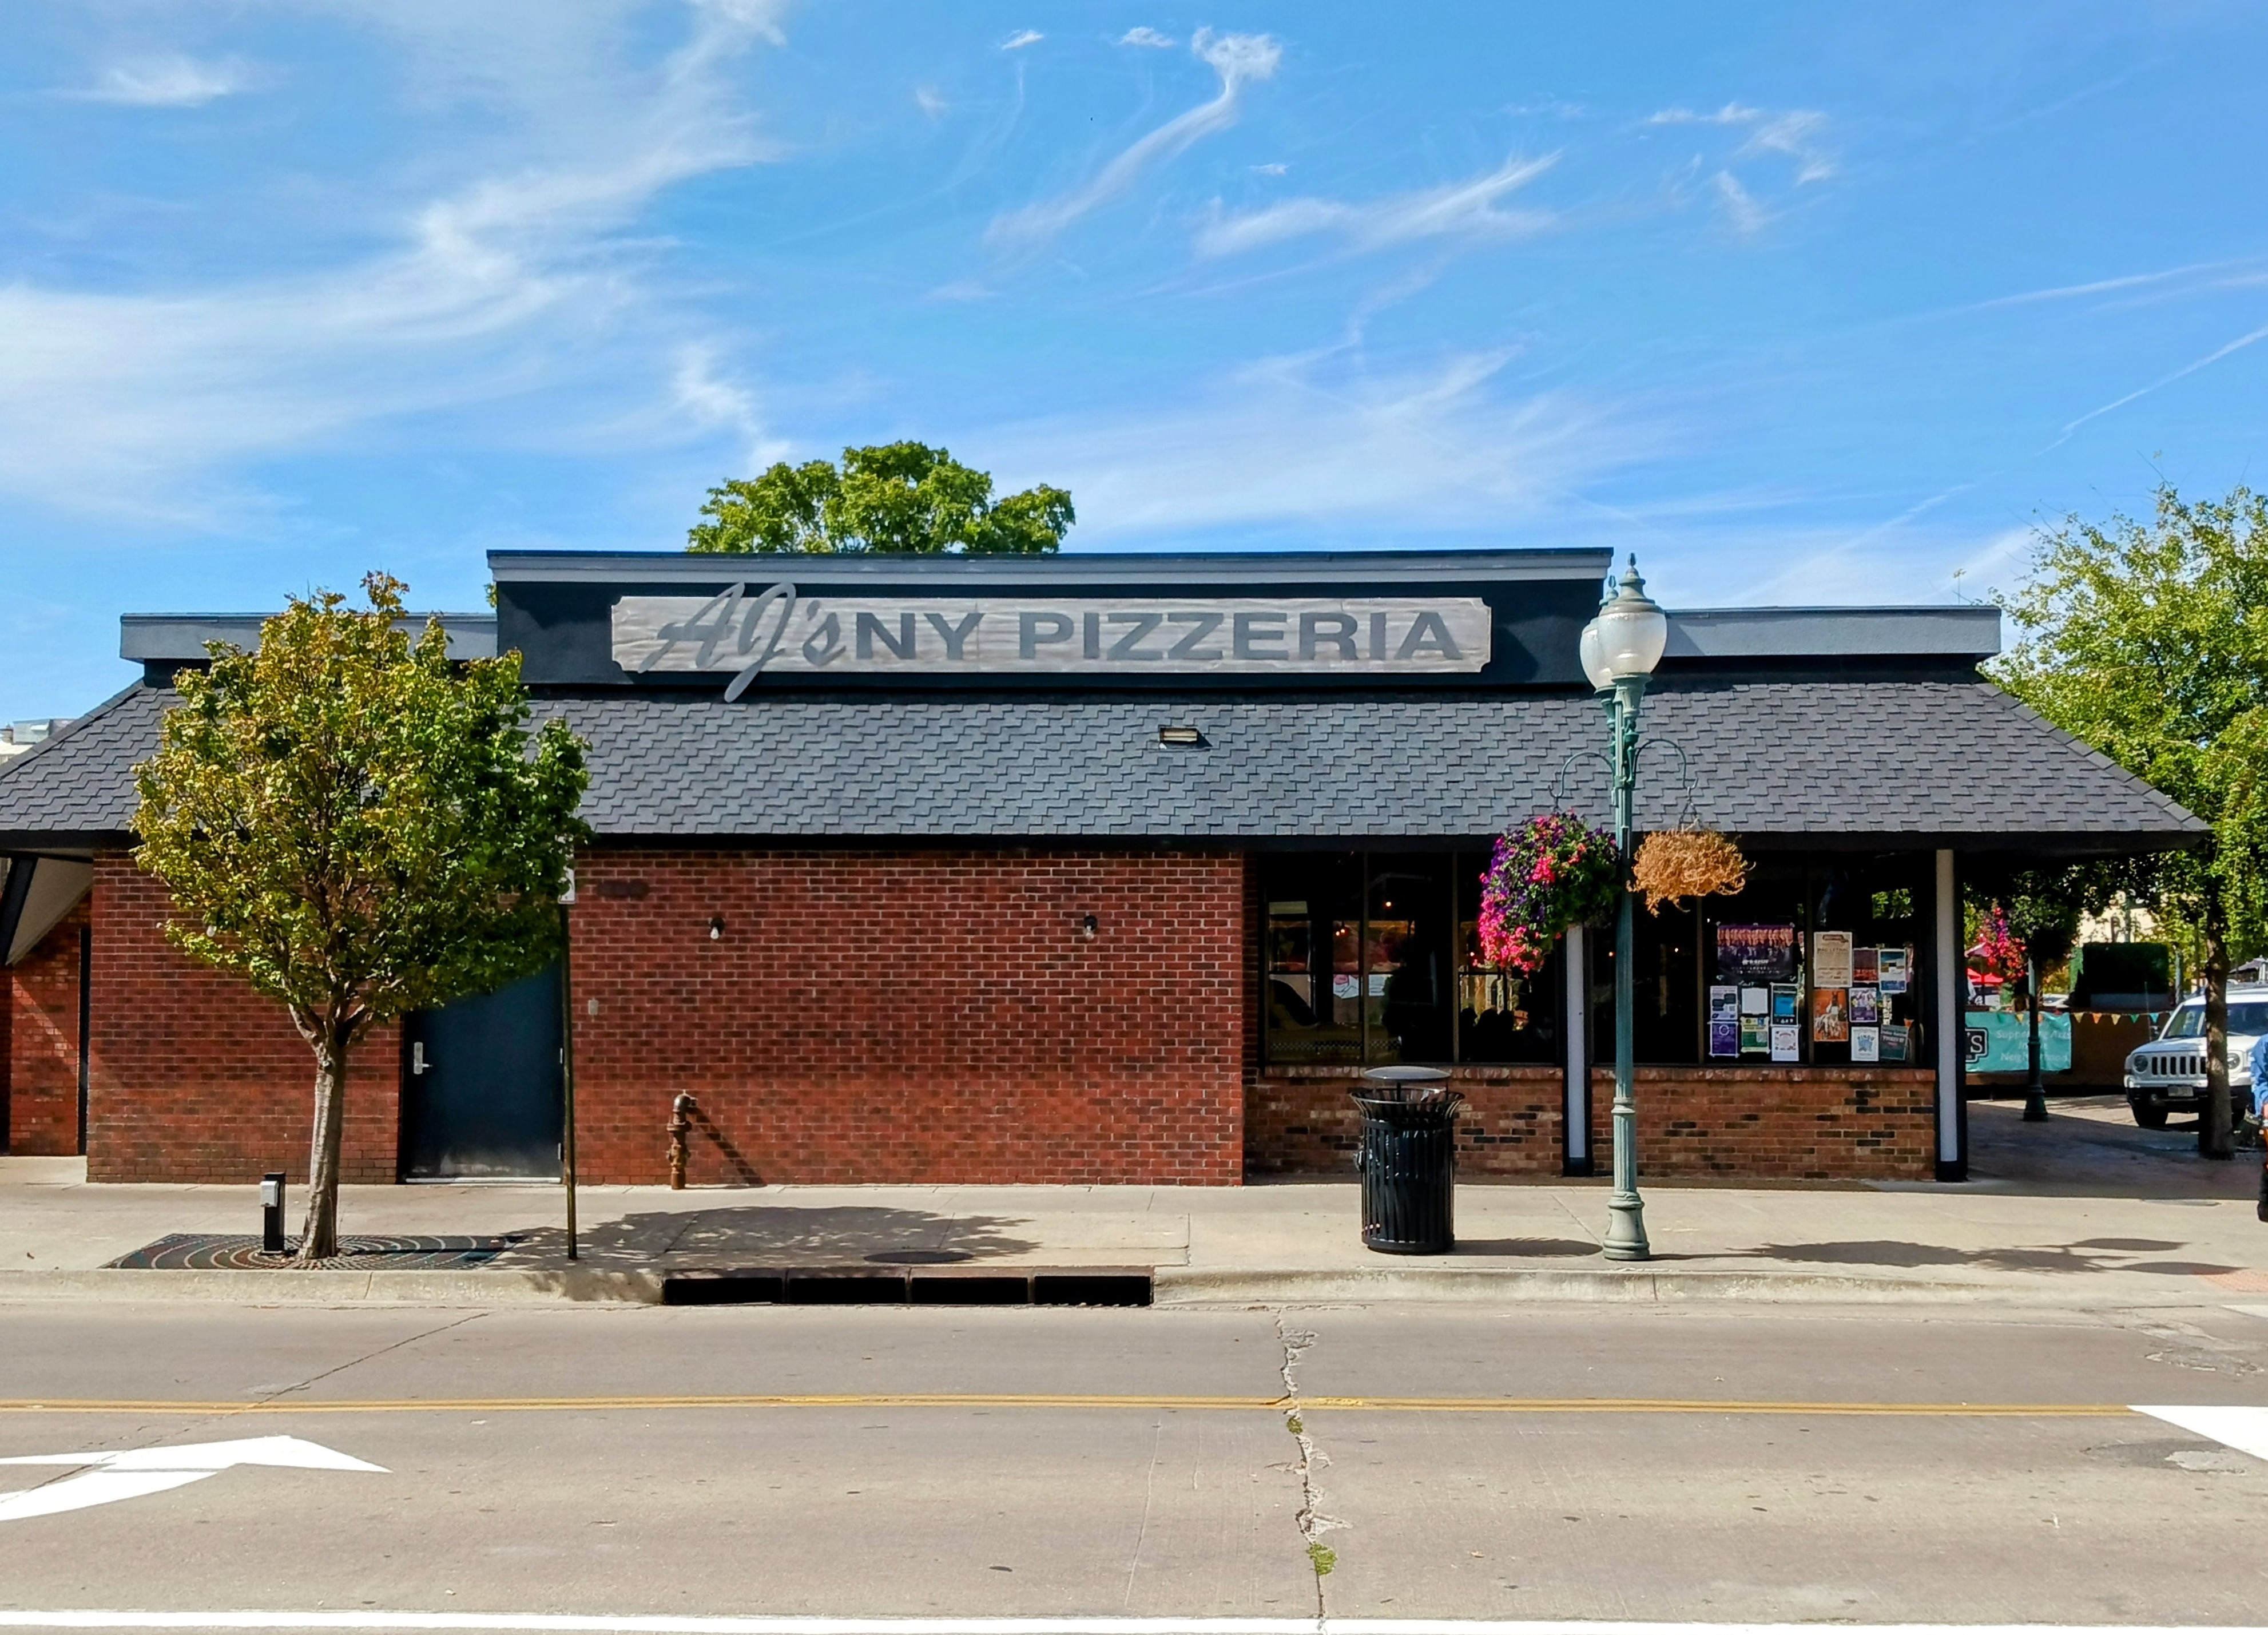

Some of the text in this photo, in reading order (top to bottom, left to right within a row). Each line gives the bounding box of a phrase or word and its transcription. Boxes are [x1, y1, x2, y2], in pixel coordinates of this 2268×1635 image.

[638, 582, 1463, 703] AJ's NY PIZZERIA
